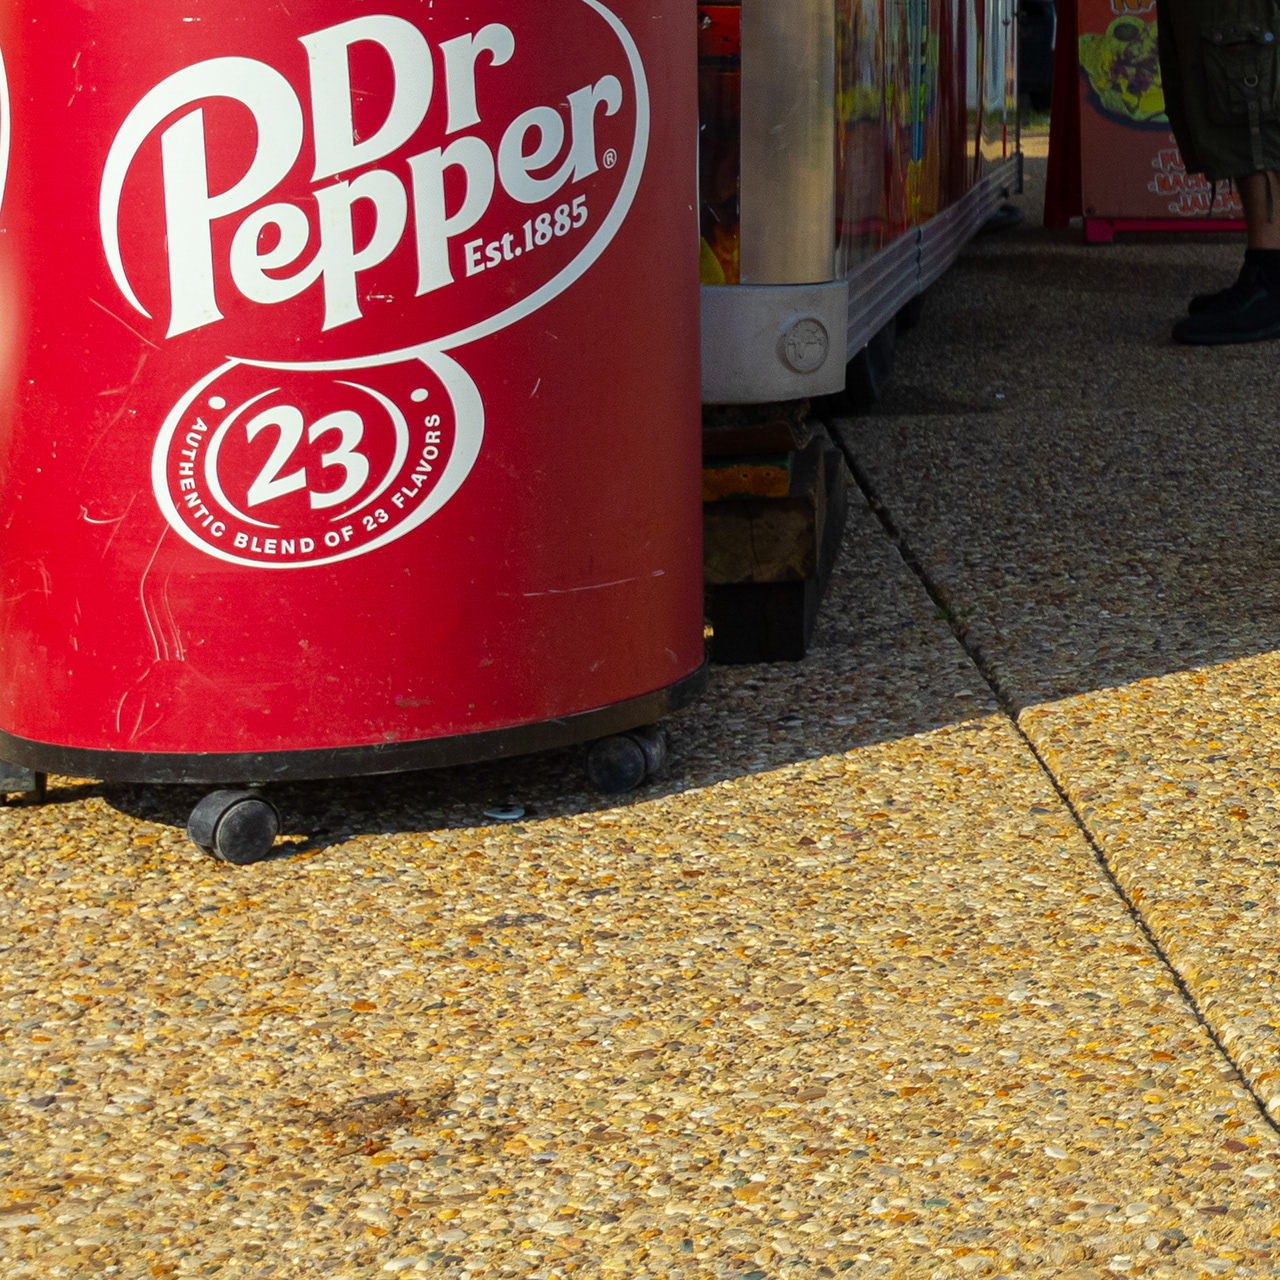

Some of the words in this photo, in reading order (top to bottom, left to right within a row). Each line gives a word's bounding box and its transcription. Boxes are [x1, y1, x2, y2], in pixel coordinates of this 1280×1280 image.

[298, 14, 516, 184] Dr
[100, 56, 624, 340] Pepper
[179, 416, 227, 538] AUTHENTIC
[233, 531, 315, 555] BLEND
[324, 524, 356, 549] OF
[362, 507, 390, 532] 23
[391, 413, 441, 509] FLAVORS
[246, 405, 370, 509] 23
